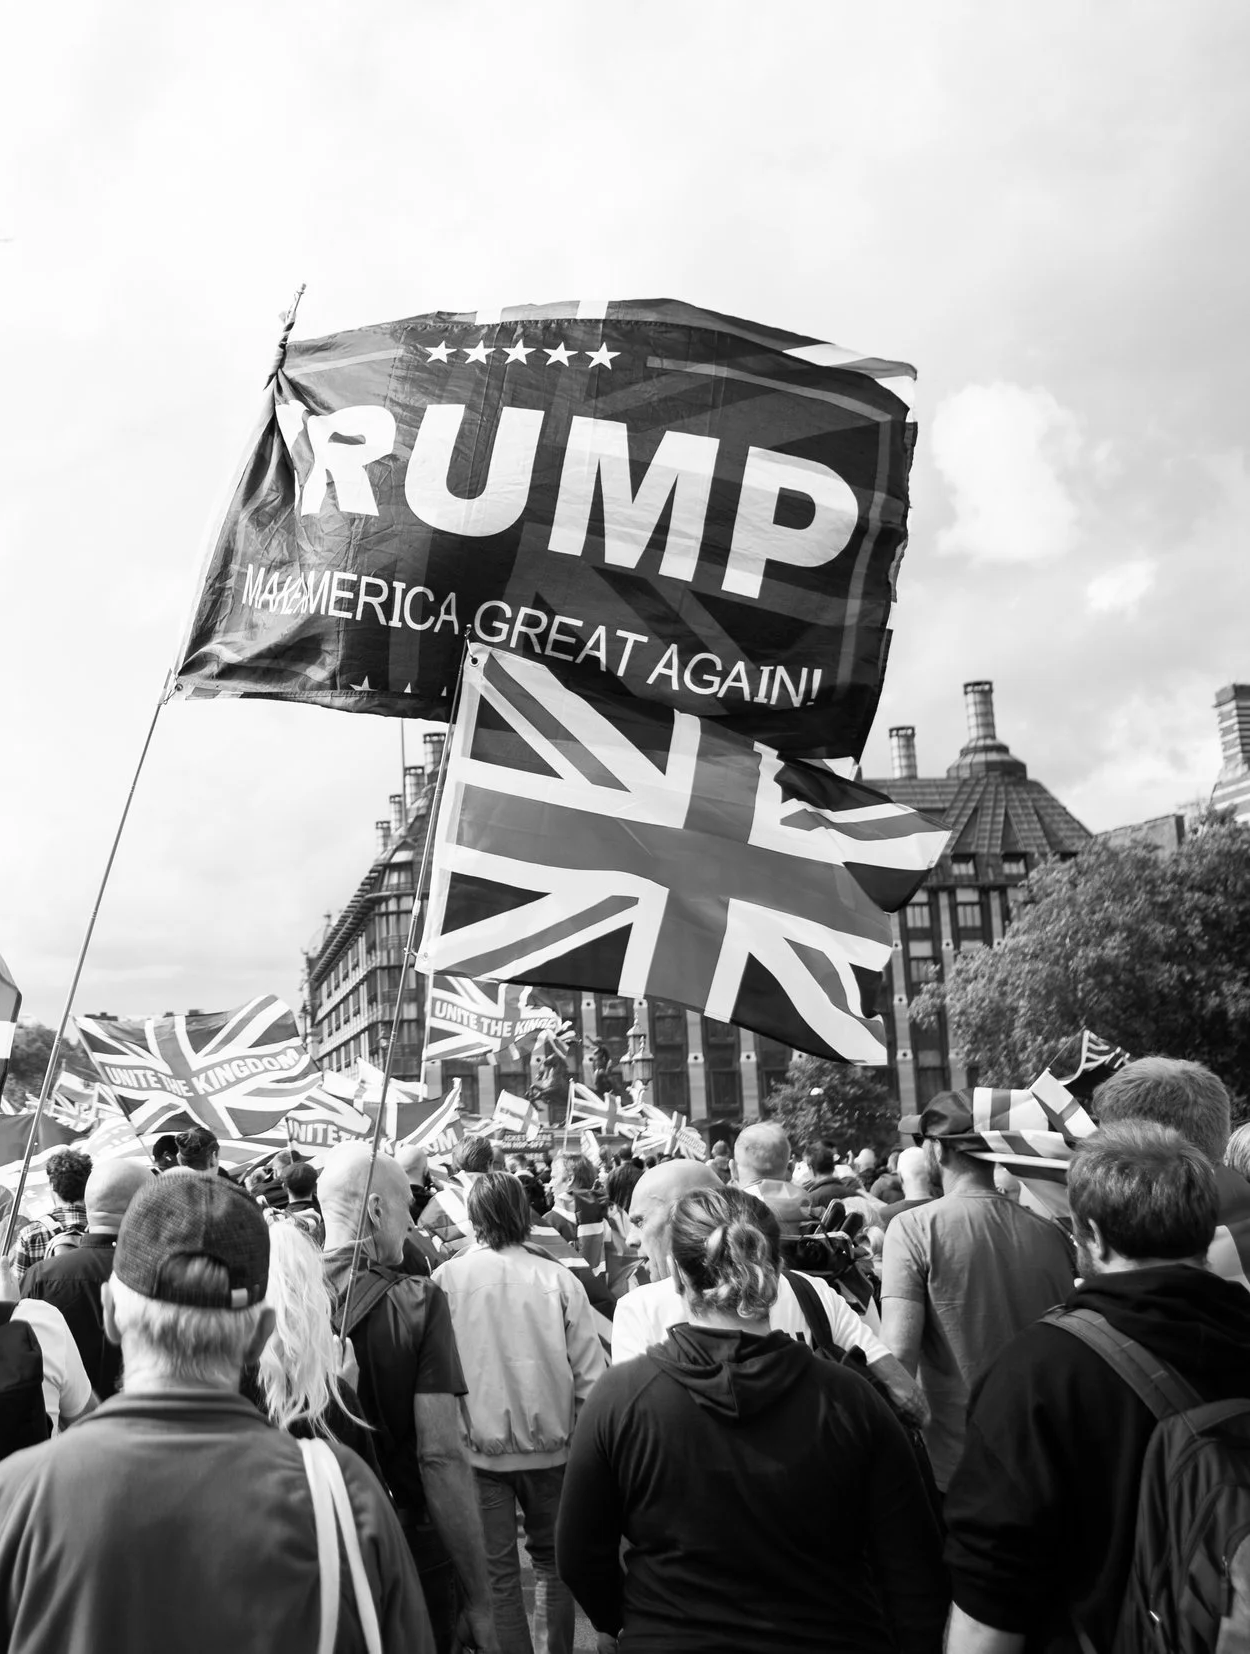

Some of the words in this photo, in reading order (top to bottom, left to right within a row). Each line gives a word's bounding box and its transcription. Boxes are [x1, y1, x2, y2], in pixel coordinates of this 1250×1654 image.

[474, 600, 649, 677] GREAT
[646, 643, 823, 708] AGAIN!
[435, 1000, 479, 1030] UNITE
[480, 1017, 513, 1038] THE
[105, 1065, 162, 1089] UNITE
[158, 1073, 194, 1098] THE
[191, 1048, 301, 1096] KINGDOM
